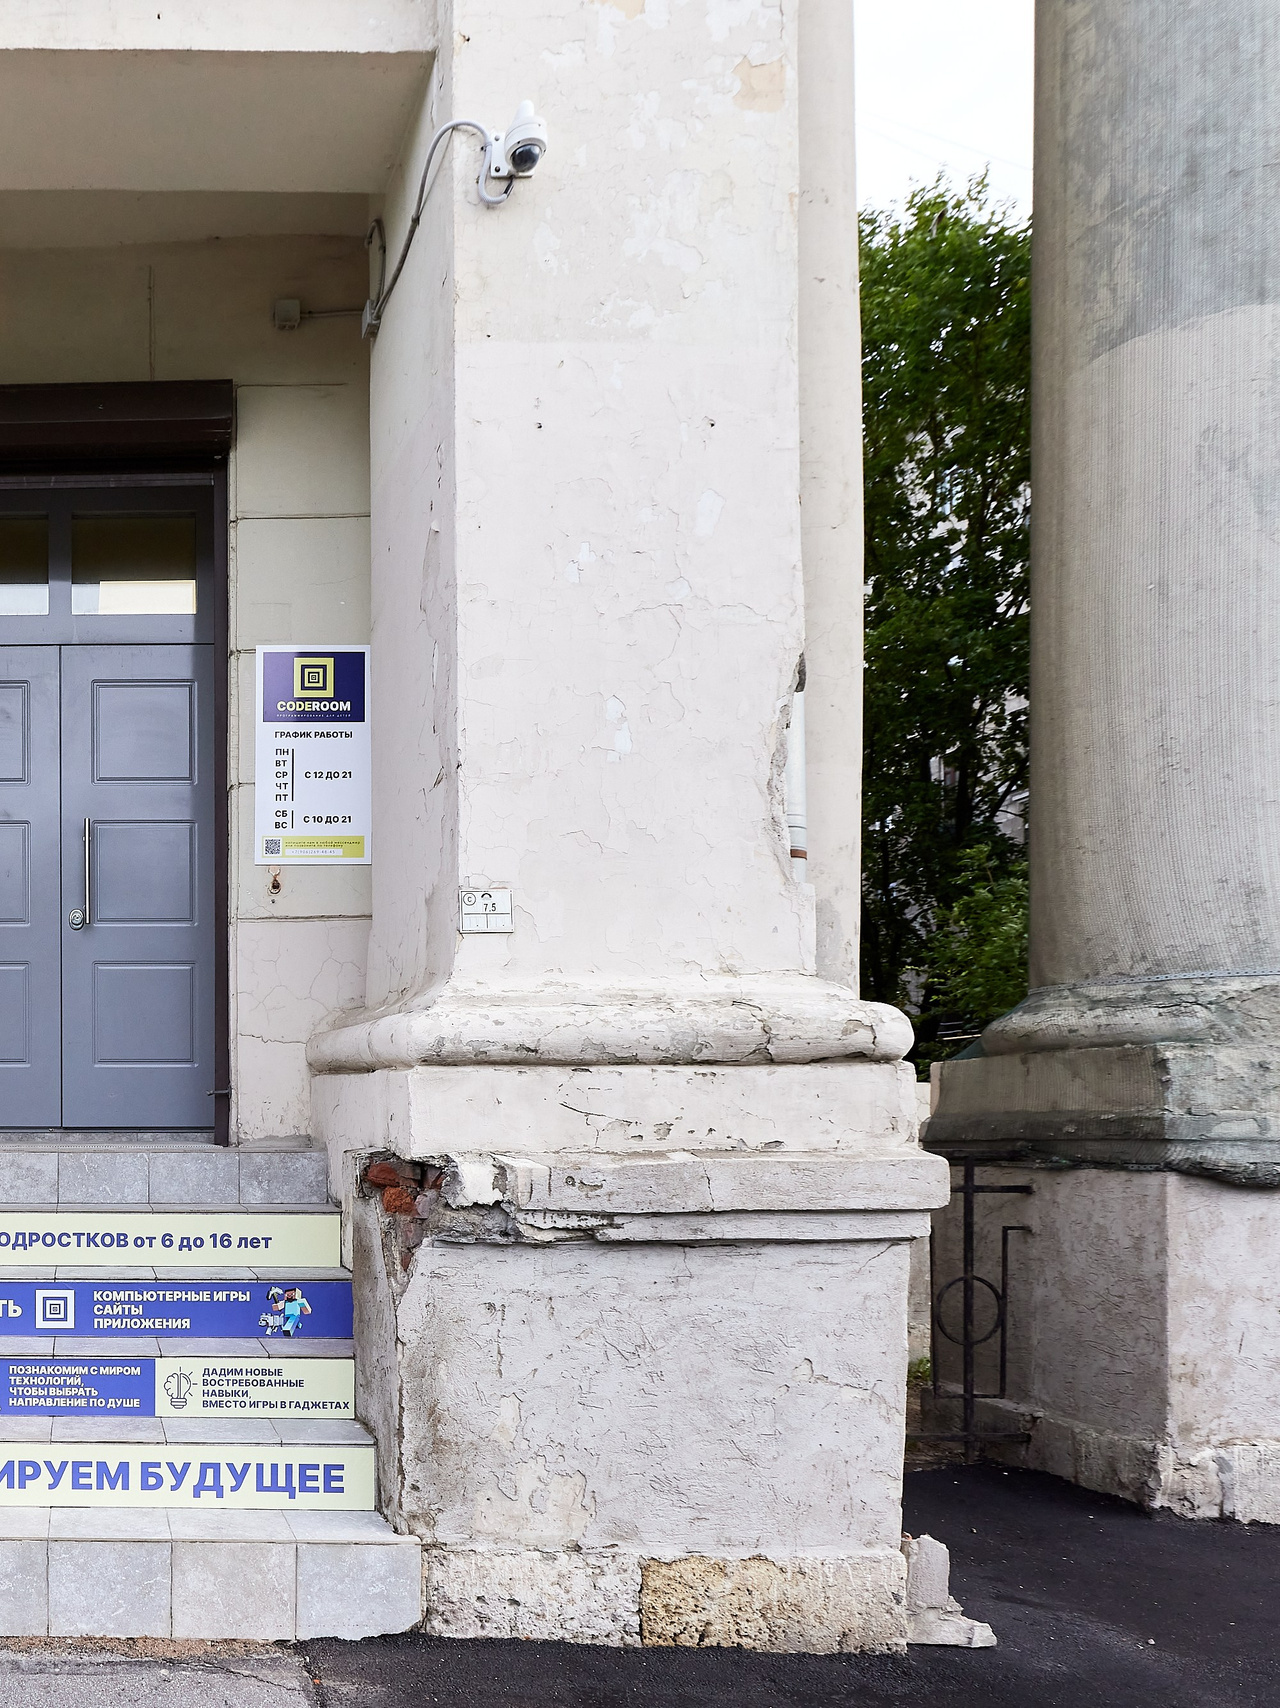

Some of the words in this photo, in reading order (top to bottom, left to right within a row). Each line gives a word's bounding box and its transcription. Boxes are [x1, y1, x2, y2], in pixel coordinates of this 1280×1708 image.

[276, 701, 351, 711] CODEROOM
[276, 748, 289, 756] ПН
[326, 771, 340, 780] ДО
[276, 782, 288, 790] ЧТ
[275, 810, 288, 818] СБ
[325, 816, 339, 824] ДО
[483, 903, 497, 912] 7.5
[133, 1237, 156, 1248] от
[161, 1233, 174, 1248] 6
[178, 1236, 205, 1251] до
[209, 1233, 232, 1248] 16
[236, 1236, 273, 1248] лет
[93, 1291, 210, 1301] КОМПЬЮТЕРНЫЕ
[213, 1291, 250, 1301] ИГРЫ
[93, 1302, 143, 1315] САЙТЫ
[93, 1318, 191, 1328] ПРИЛОЖЕНИЯ
[9, 1366, 88, 1374] ПОЗНАКОМИМ
[90, 1366, 98, 1374] С
[100, 1367, 140, 1375] МИРОМ
[203, 1368, 243, 1376] ДАДИМ
[246, 1368, 282, 1376] НОВЫЕ
[9, 1376, 84, 1386] ТЕХНОЛОГИЙ,
[202, 1379, 304, 1387] ВОСТРЕБОВАННЫЕ
[9, 1388, 47, 1396] ЧТОБЫ
[50, 1388, 98, 1396] ВЫБРАТЬ
[202, 1390, 252, 1399] НАВЫКИ,
[9, 1398, 87, 1406] НАПРАВЛЕНИЕ
[107, 1399, 140, 1408] ДУШЕ
[202, 1400, 246, 1408] ВМЕСТО
[289, 1401, 350, 1410] ГАДЖЕТАХ
[141, 1462, 345, 1498] БУДУЩЕЕ
